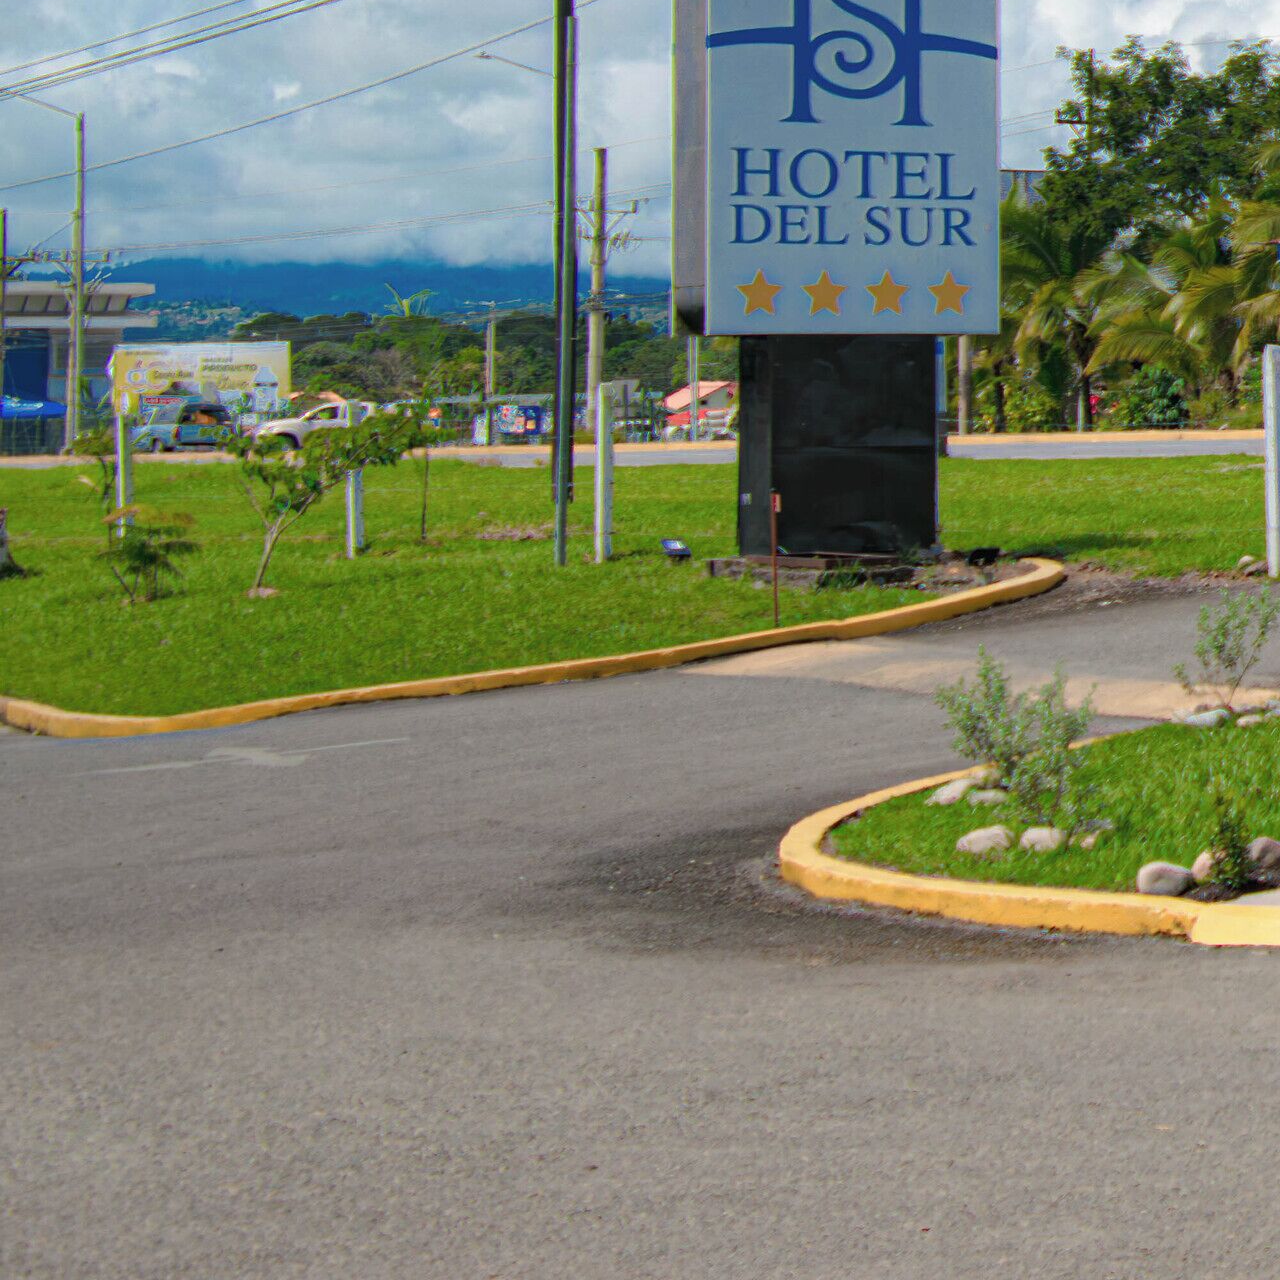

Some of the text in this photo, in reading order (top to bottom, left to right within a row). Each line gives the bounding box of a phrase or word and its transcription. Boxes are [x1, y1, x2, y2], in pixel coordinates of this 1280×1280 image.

[730, 147, 977, 201] HOTEL
[729, 203, 977, 247] DEL SUR
